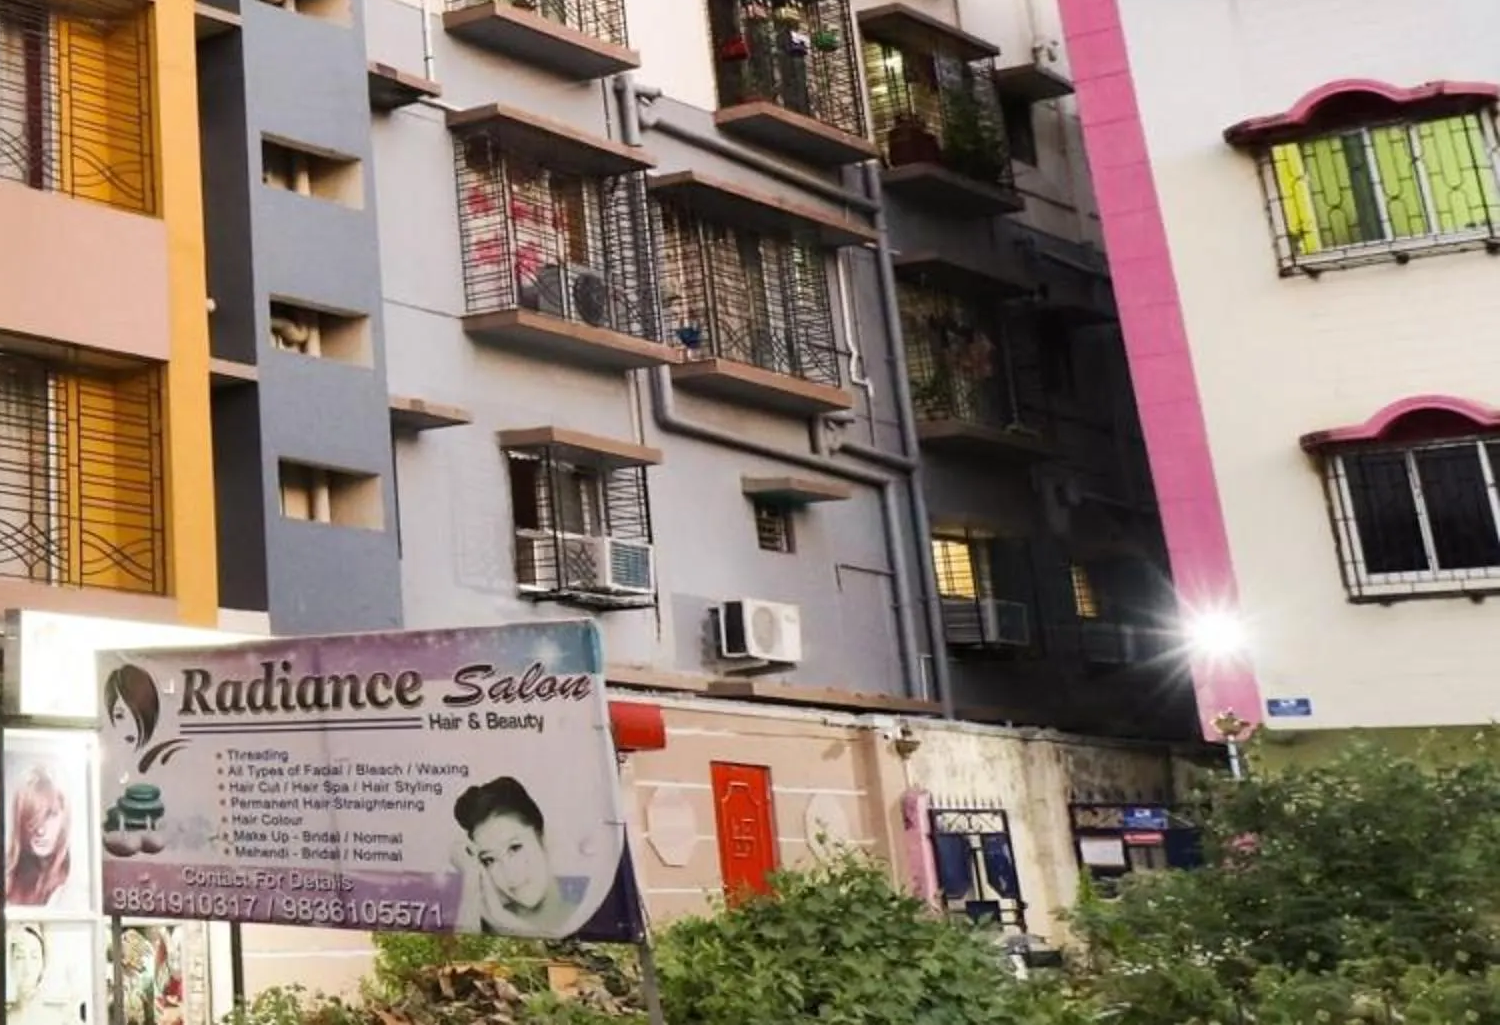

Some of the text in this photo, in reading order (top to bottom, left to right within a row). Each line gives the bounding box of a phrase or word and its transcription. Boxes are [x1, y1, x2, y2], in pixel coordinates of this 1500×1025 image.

[177, 661, 594, 717] Radiance Salon
[428, 712, 545, 733] Hair & Beauty
[227, 749, 289, 763] Threading
[228, 764, 243, 777] All
[247, 764, 285, 781] Types
[287, 763, 300, 776] of
[303, 763, 344, 776] Facial
[355, 762, 403, 776] Bleach
[415, 761, 469, 778] Waxing
[229, 781, 254, 793] Hair
[258, 781, 281, 794] Cut
[292, 781, 319, 793] Hair
[323, 781, 350, 796] Spa
[362, 780, 389, 793] Hair
[394, 780, 443, 796] Styling
[231, 797, 426, 813] Permanent Hair Straightening
[232, 814, 304, 826] Hair Colour
[233, 830, 268, 843] Make
[271, 830, 290, 845] Up
[302, 830, 341, 844] Bridal
[353, 832, 403, 844] Normal
[302, 846, 341, 860] Bridal
[353, 848, 403, 862] Normal
[182, 866, 355, 892] Contact For Details
[112, 886, 444, 927] 9831910317 / 9836105571
